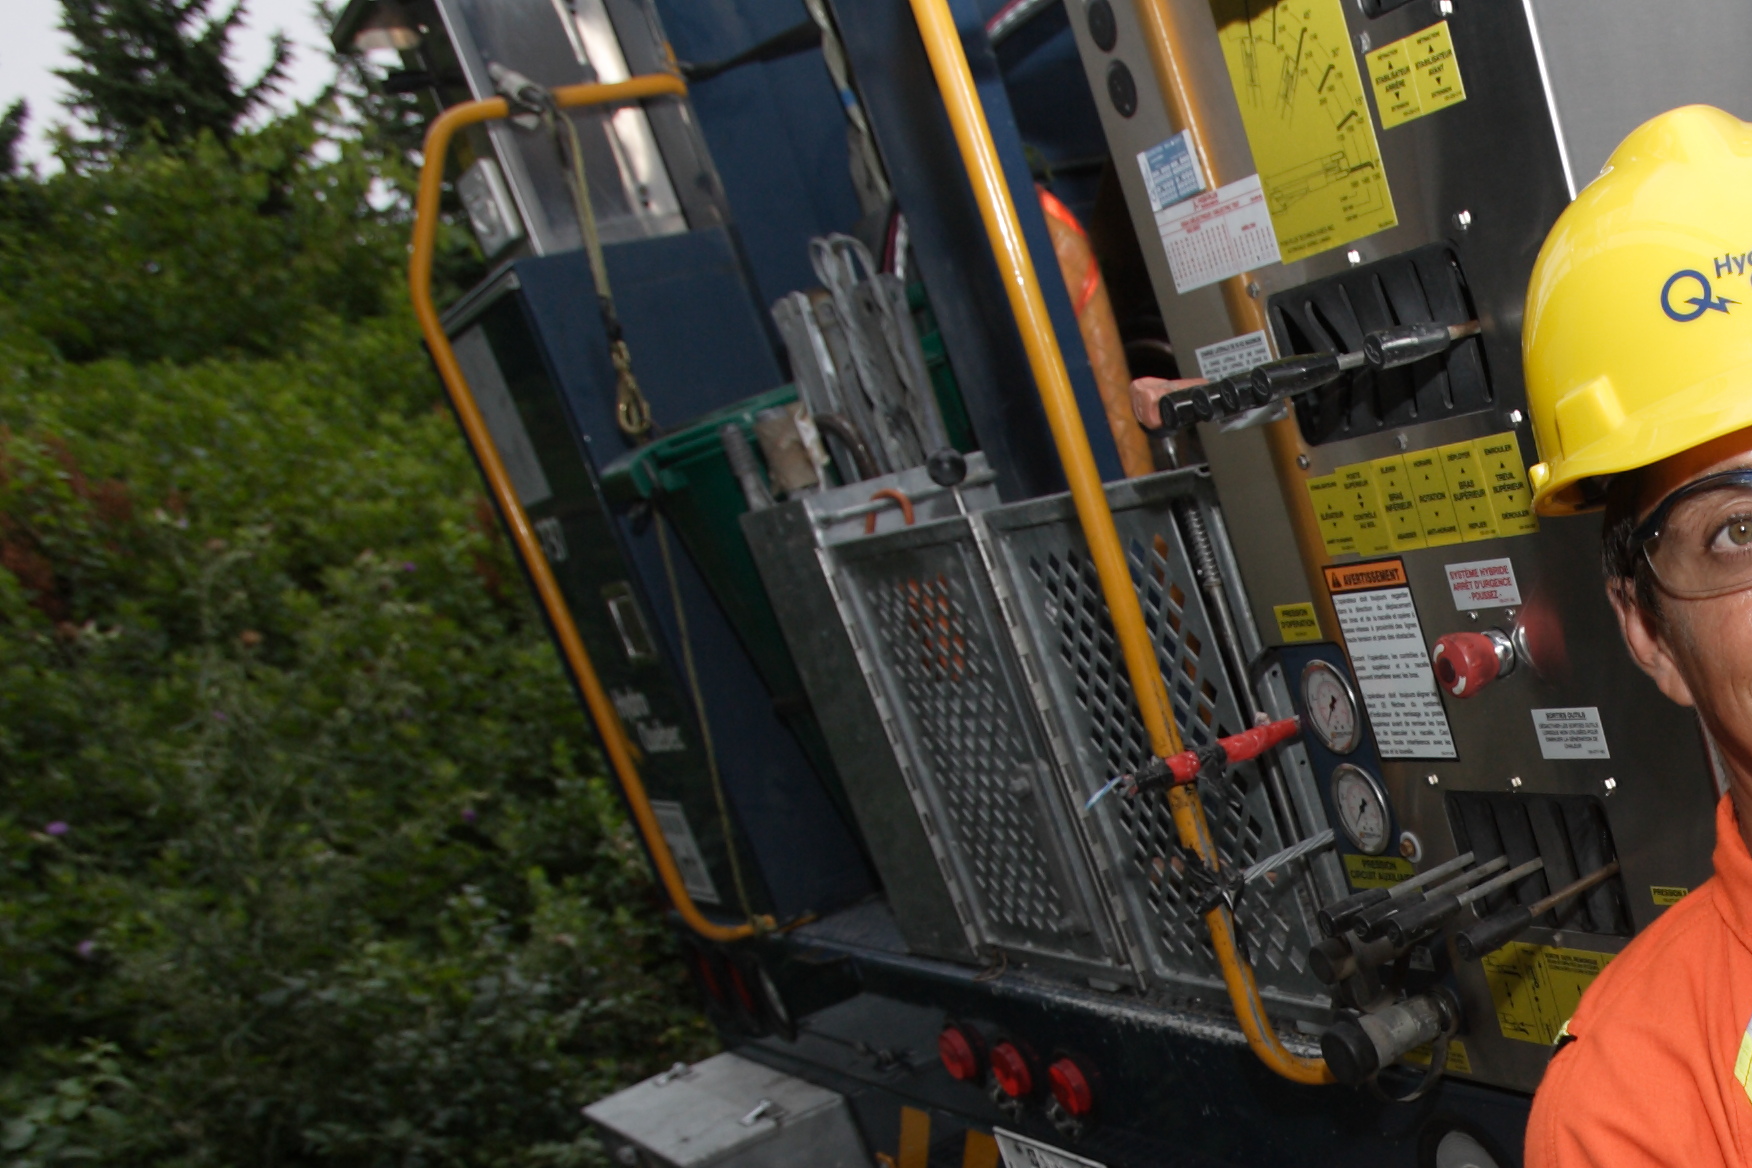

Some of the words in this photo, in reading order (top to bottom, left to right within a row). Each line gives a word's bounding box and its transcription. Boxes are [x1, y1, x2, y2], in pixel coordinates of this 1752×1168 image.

[1343, 568, 1399, 585] AVERTISSEMENT
[1449, 568, 1479, 580] SYSTÈME
[1479, 565, 1509, 576] HYBRIDE
[1453, 579, 1473, 591] ARRÊT
[1474, 577, 1513, 589] D'URGENCE
